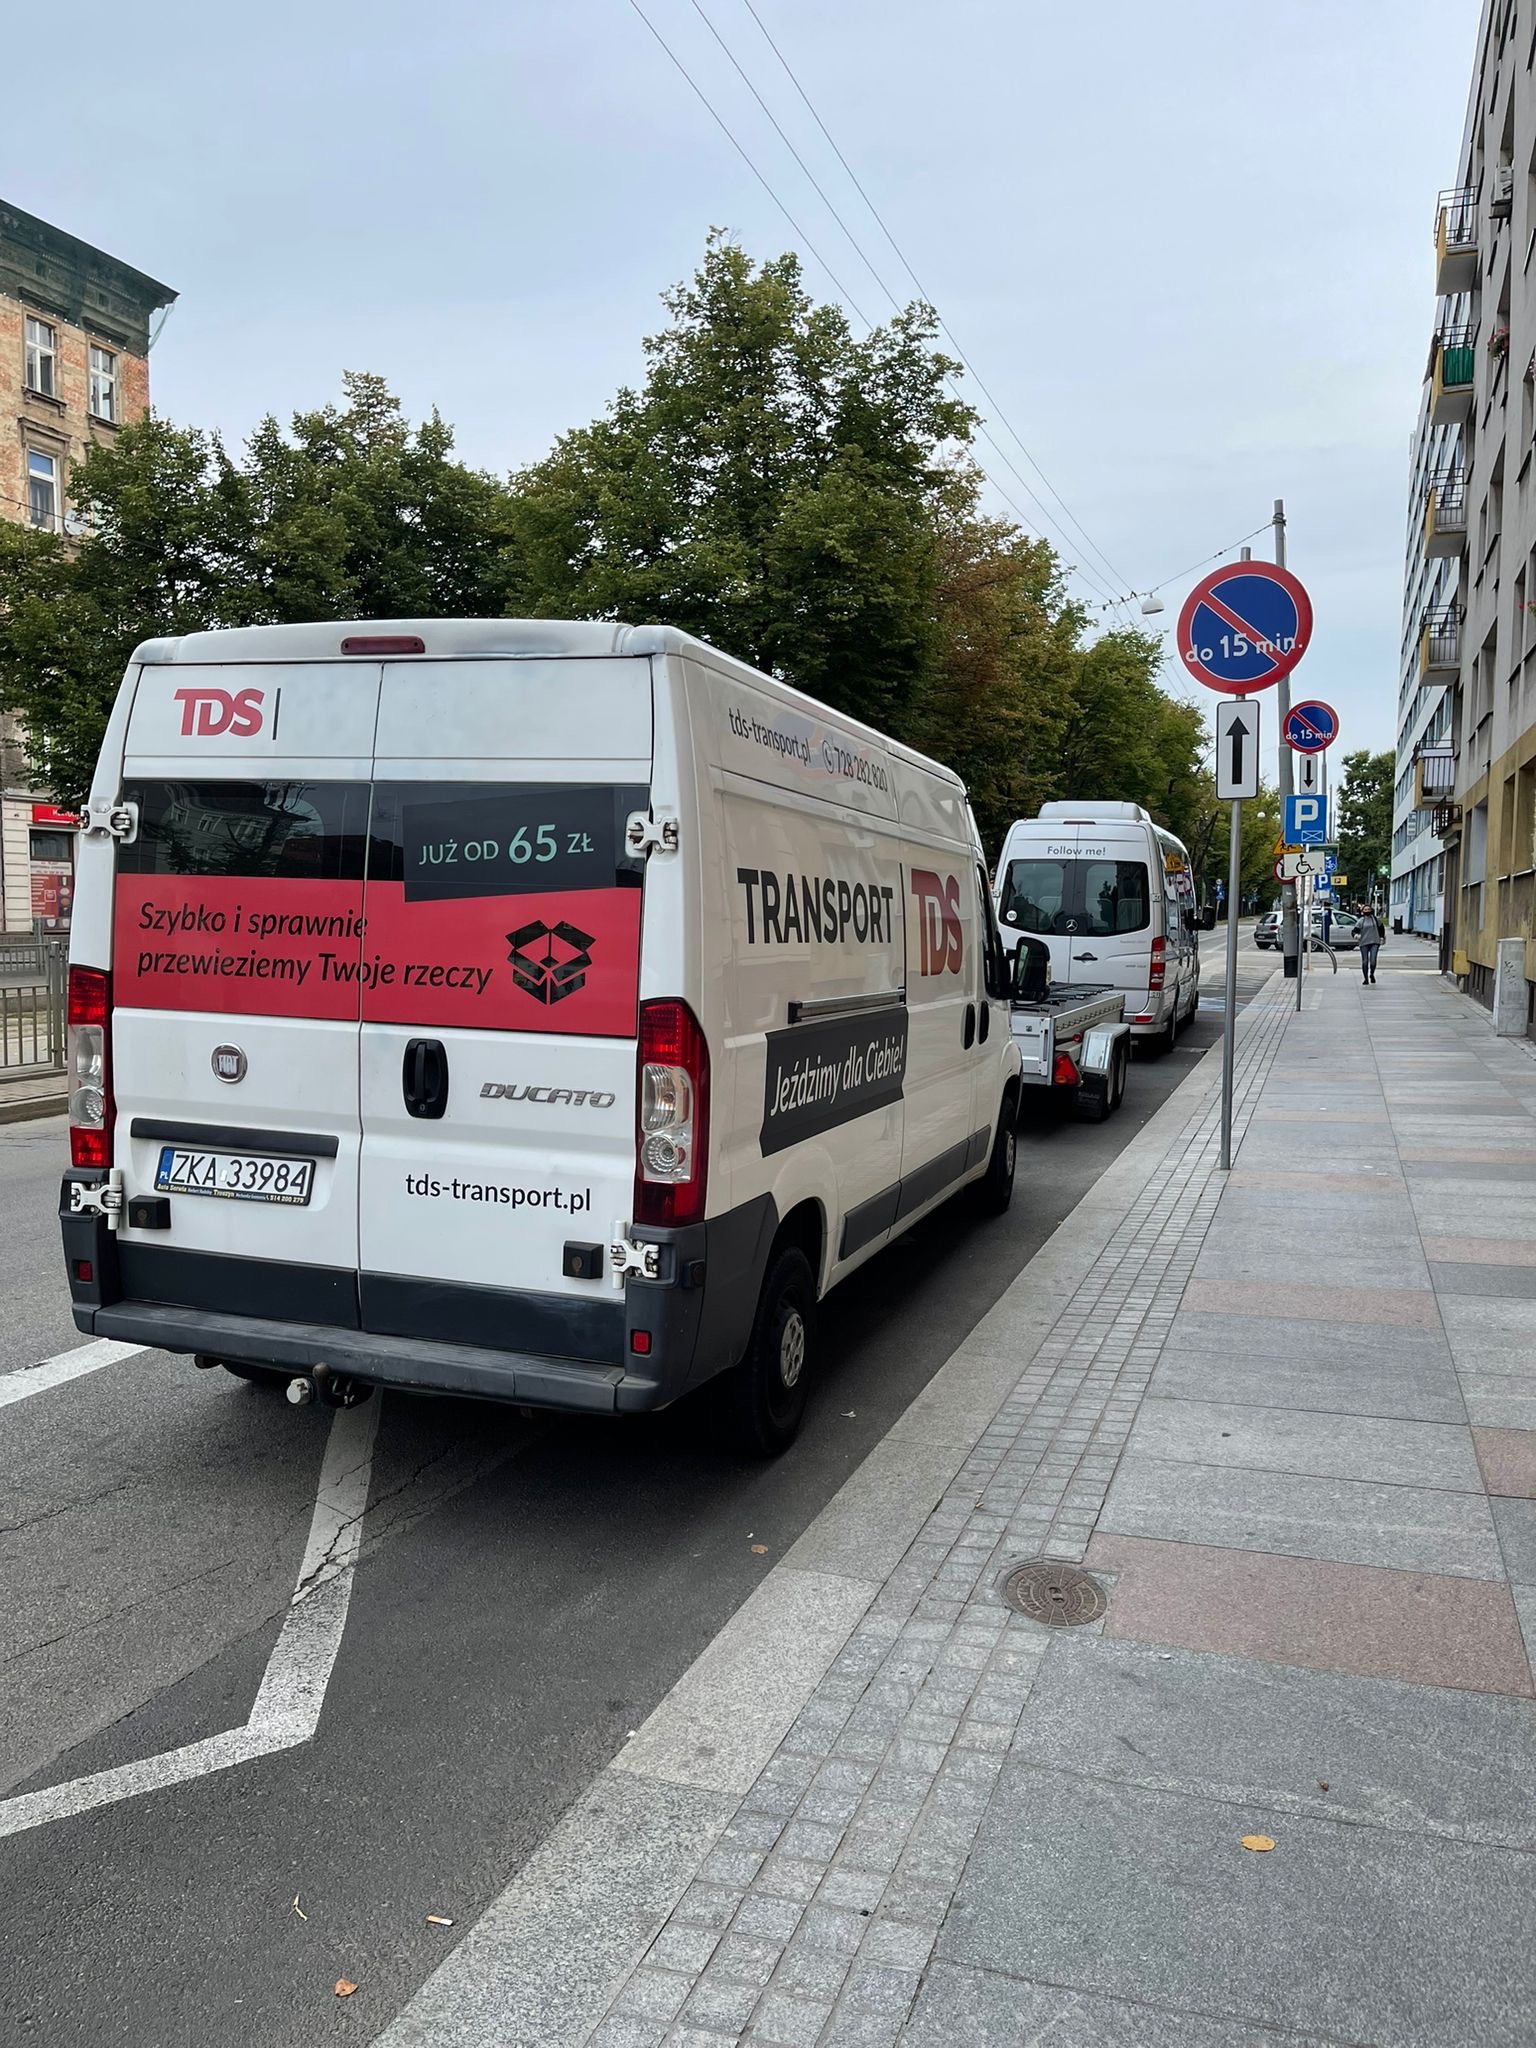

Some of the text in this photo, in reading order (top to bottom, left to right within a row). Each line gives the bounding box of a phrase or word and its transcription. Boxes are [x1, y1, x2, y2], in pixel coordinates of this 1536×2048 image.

[1185, 633, 1303, 662] do 15 min.
[174, 688, 265, 737] TDS
[728, 707, 888, 792] tds-transport.pl 728 282 820
[1286, 731, 1298, 740] do
[1300, 729, 1313, 740] 15
[1295, 799, 1319, 830] P
[419, 824, 594, 865] JUŻ OD 65 ZŁ
[1047, 846, 1106, 856] Follow me!
[1318, 874, 1328, 888] P
[138, 901, 368, 939] Szybko i sprawnie
[737, 867, 893, 944] TRANSPORT
[911, 868, 963, 977] TDS
[137, 947, 493, 994] przewieziemy Twoje rzeczy
[219, 1054, 239, 1074] FIAT
[770, 1034, 904, 1117] Jeździmy dla Ciebie!
[480, 1082, 615, 1108] DUCATO
[160, 1170, 168, 1180] PL
[171, 1154, 308, 1195] ZKA 33984
[405, 1173, 591, 1215] tds-transport.pl
